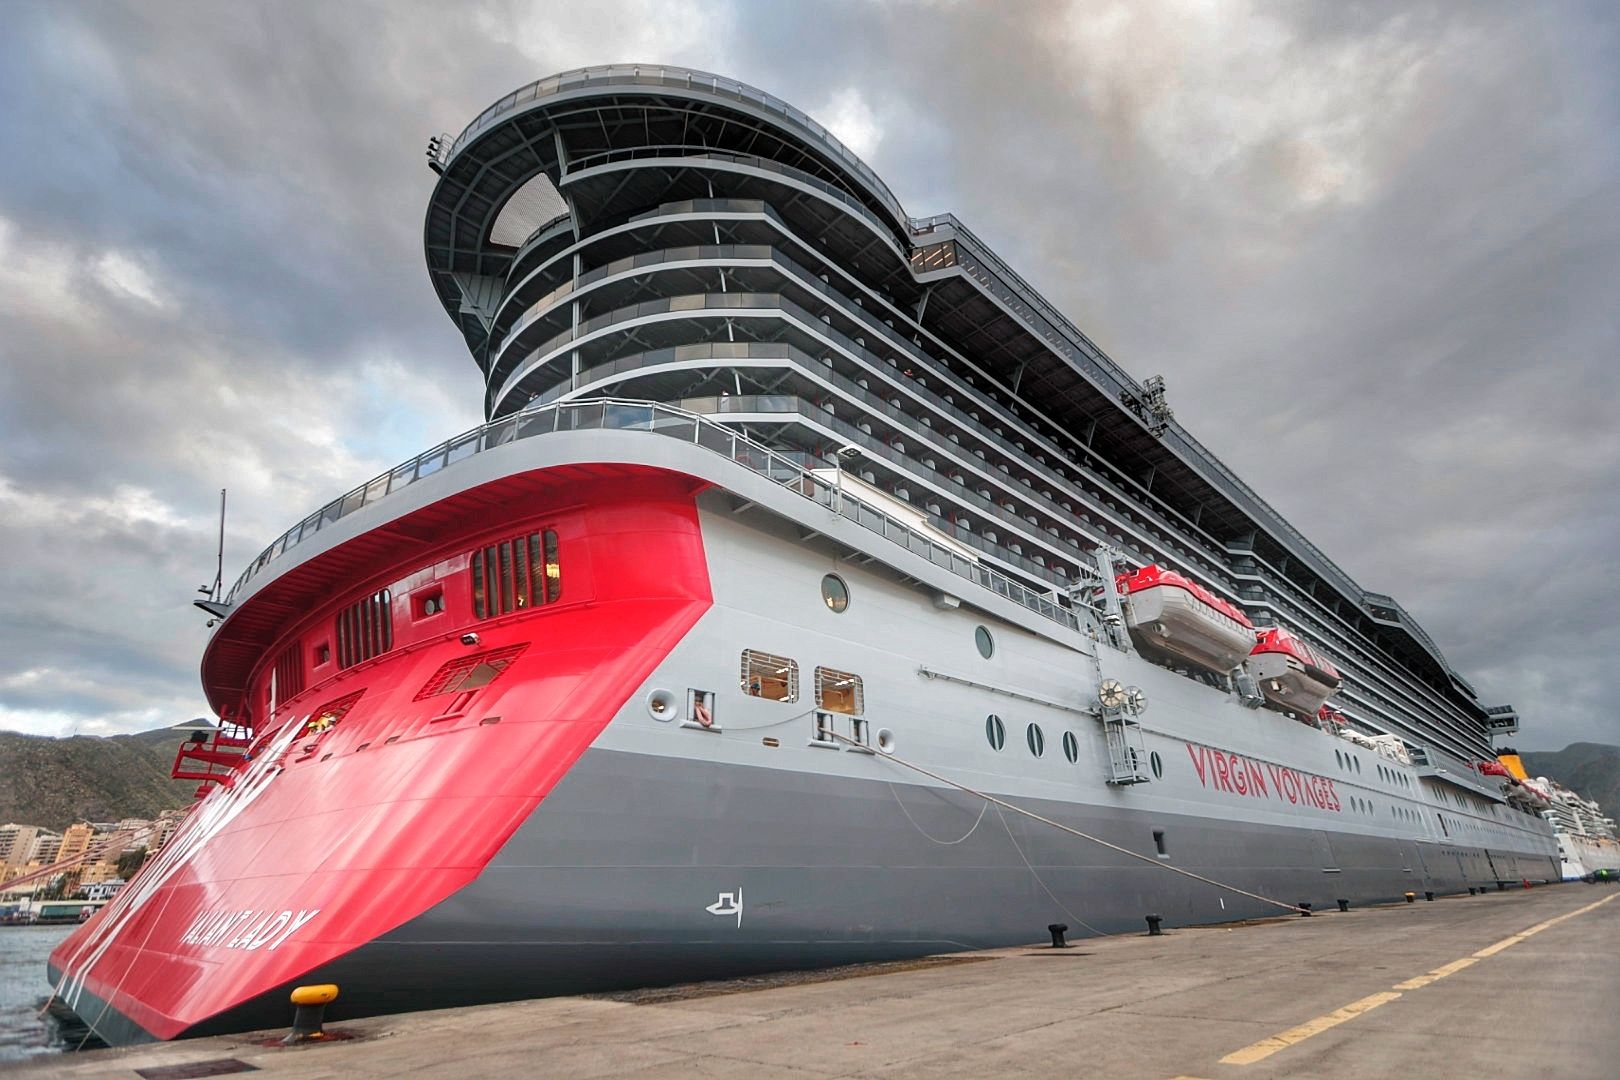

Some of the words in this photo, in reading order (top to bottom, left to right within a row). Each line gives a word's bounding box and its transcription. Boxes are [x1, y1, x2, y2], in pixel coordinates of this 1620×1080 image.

[1186, 743, 1269, 798] VIRGIN
[1266, 763, 1341, 812] VOYAGES
[178, 910, 254, 947] VALIANT
[226, 909, 321, 951] LADY
